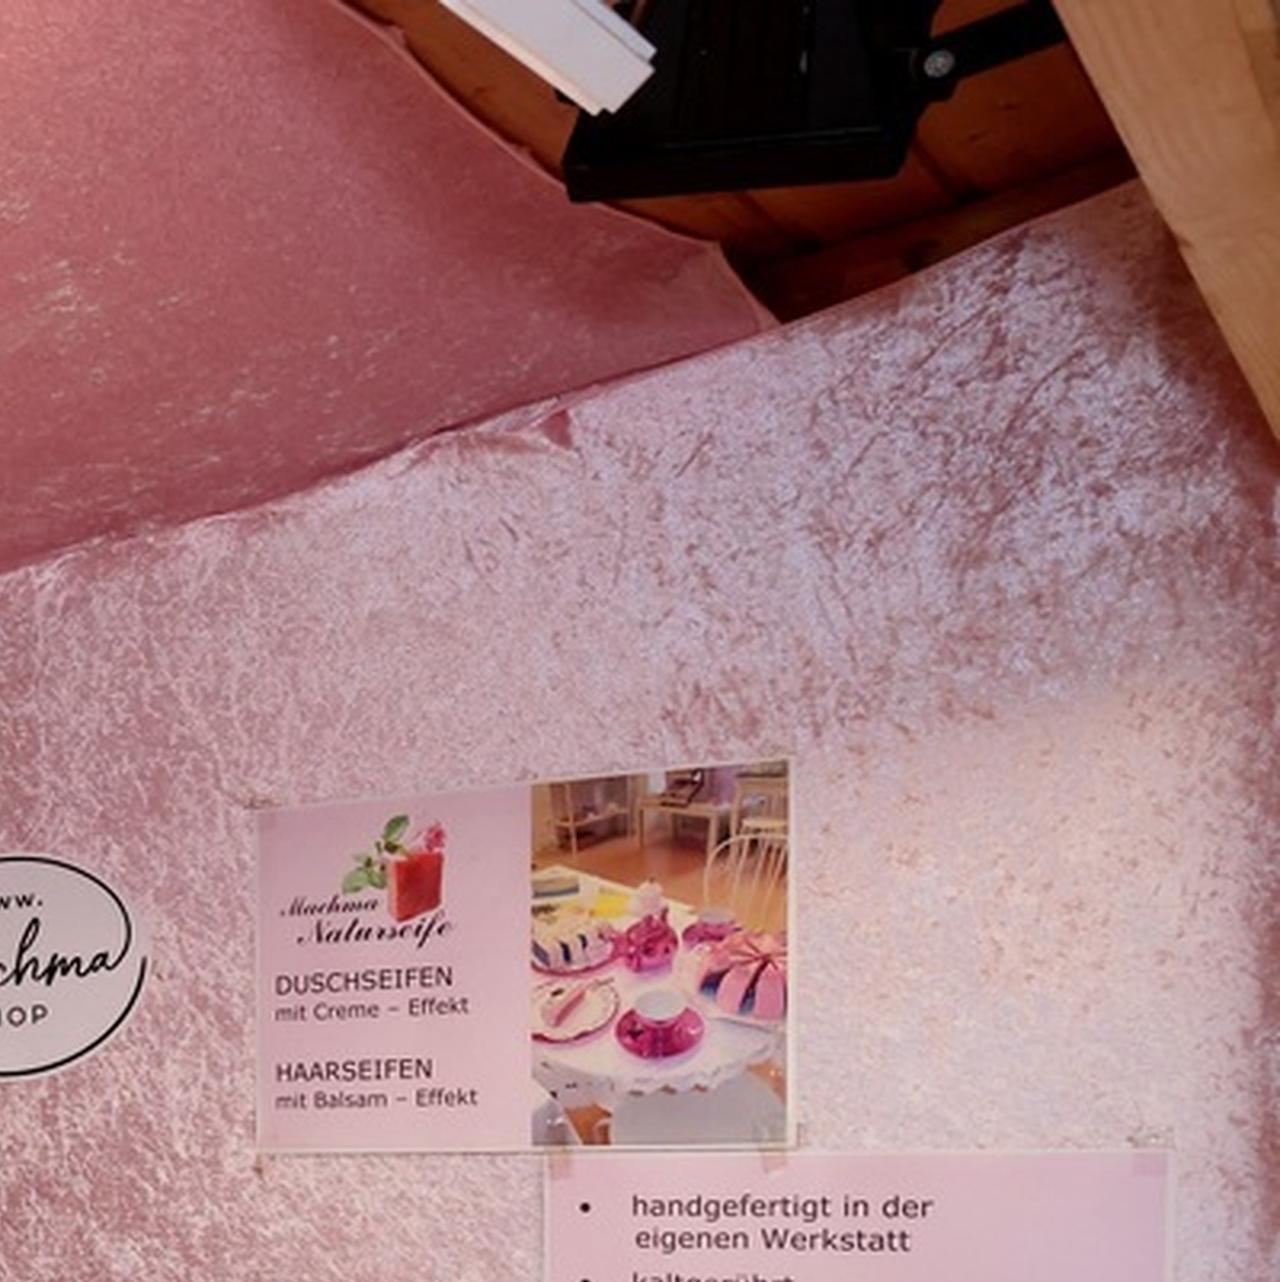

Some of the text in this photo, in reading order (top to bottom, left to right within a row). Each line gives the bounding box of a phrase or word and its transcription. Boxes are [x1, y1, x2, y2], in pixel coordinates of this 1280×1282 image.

[280, 894, 379, 919] Machma
[295, 915, 454, 952] Naturseife
[274, 966, 454, 997] DUSCHSEIFEN
[274, 1003, 307, 1024] mit
[312, 1000, 381, 1022] Creme
[407, 995, 470, 1018] Effekt
[274, 1057, 434, 1084] HAARSEIFEN
[274, 1092, 307, 1111] mit
[312, 1088, 389, 1110] Balsam
[415, 1086, 479, 1109] Effekt
[631, 1193, 935, 1223] handgefertigt in der
[634, 1228, 912, 1256] eigenen Werkstatt
